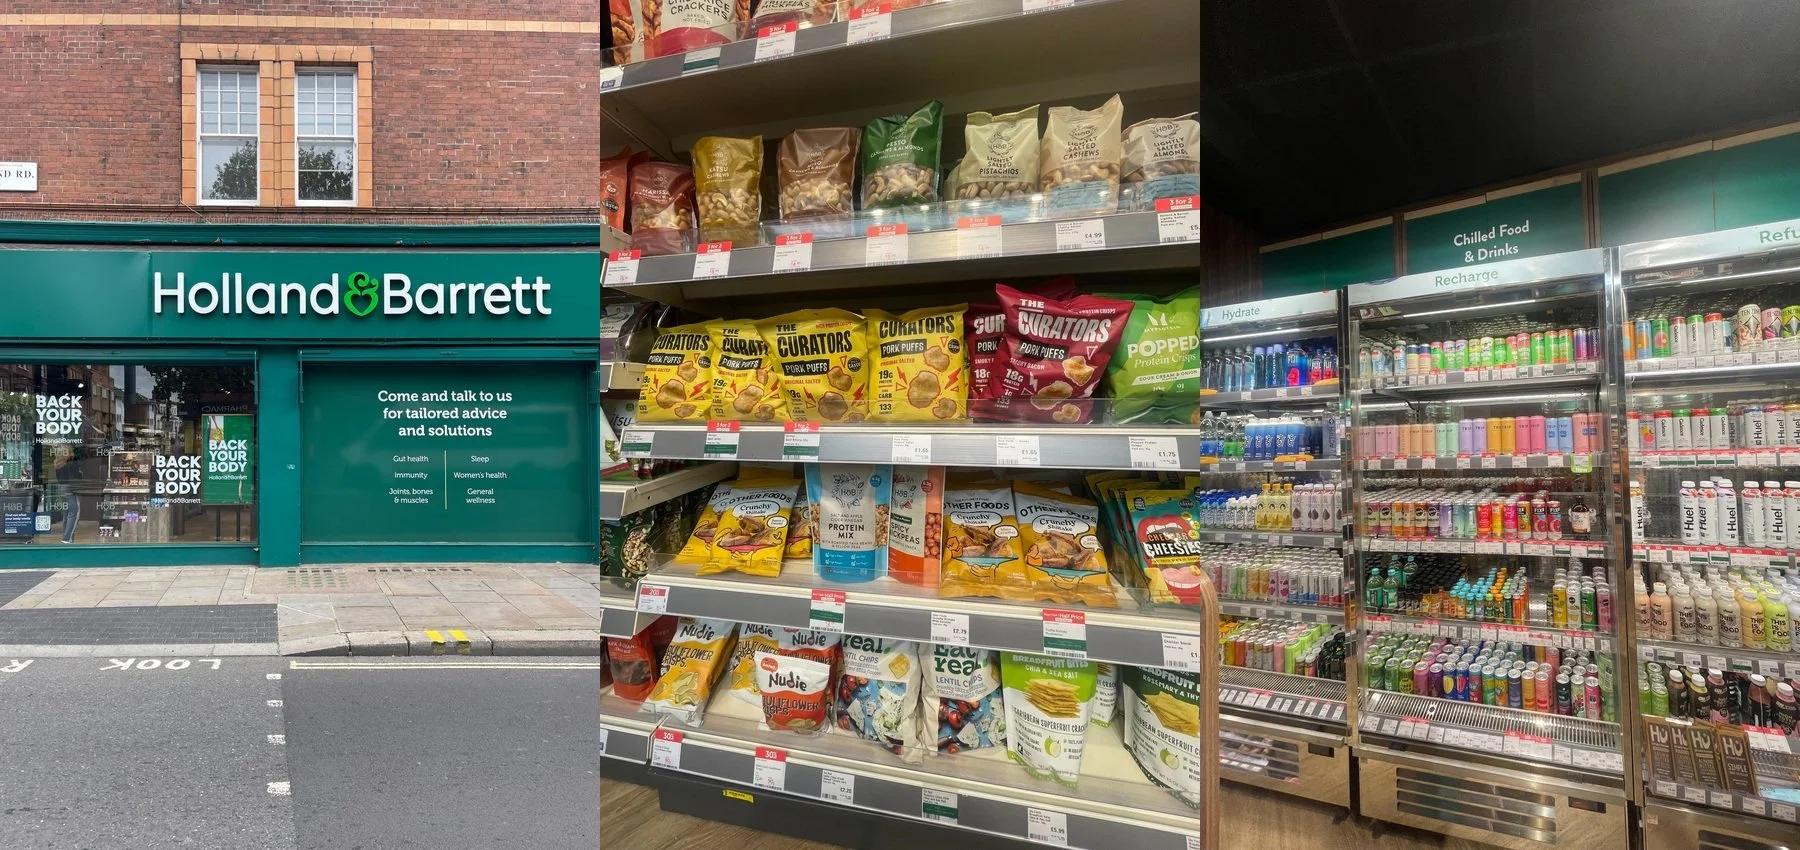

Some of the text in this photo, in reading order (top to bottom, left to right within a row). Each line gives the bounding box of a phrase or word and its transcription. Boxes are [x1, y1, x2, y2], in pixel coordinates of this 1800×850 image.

[670, 2, 729, 20] CRACKERS
[886, 139, 907, 148] PESTO
[1067, 136, 1098, 147] LIGHTLY
[1068, 142, 1096, 153] SALTED
[1153, 137, 1185, 147] LIGHTLY
[1157, 143, 1185, 151] SALTED
[897, 144, 924, 152] ALMONDS
[1063, 149, 1100, 160] CASHEWS
[16, 170, 35, 178] RD.
[642, 188, 670, 196] HARISSA
[1453, 220, 1530, 247] Chilled Food
[1464, 243, 1519, 263] & Drinks
[1434, 268, 1499, 288] Recharge
[154, 271, 552, 317] Holland&Barrett
[1019, 299, 1045, 309] THE
[1222, 305, 1261, 320] Hydrate
[776, 324, 797, 332] THE
[879, 315, 955, 339] CURATORS
[1018, 311, 1112, 343] CURATORS
[653, 334, 710, 350] CURATORS
[777, 330, 853, 358] CURATORS
[882, 342, 924, 354] PORK PUFFS
[977, 340, 997, 351] PORK
[1128, 335, 1200, 359] POPPED
[1019, 343, 1065, 359] PORK PUFFS
[649, 355, 682, 364] PORK PUFFS
[722, 357, 740, 368] PORK
[741, 359, 759, 368] PUFFS
[1134, 353, 1196, 369] Protein Crisps
[785, 362, 828, 374] PORK PUFFS
[878, 370, 893, 379] 19G
[1005, 368, 1024, 382] 18G
[713, 378, 727, 387] 19G
[1004, 378, 1020, 386] PROTEIN
[36, 395, 83, 408] BACK
[378, 390, 513, 402] Come and talk to us
[36, 409, 83, 421] YOUR
[383, 407, 508, 419] for tailored advice
[611, 411, 632, 427] itsu
[36, 422, 83, 434] BODY
[398, 425, 492, 437] and solutions
[1753, 420, 1762, 440] Huel
[1777, 418, 1785, 439] Huel
[209, 439, 248, 450] BACK
[156, 456, 201, 468] BACK
[209, 451, 248, 461] YOUR
[393, 455, 429, 463] Gut health
[471, 455, 490, 464] Sleep
[209, 462, 248, 472] BODY
[156, 469, 201, 481] YOUR
[394, 472, 428, 480] Immunity
[155, 482, 201, 494] BODY
[389, 488, 411, 496] Joints,
[394, 496, 429, 504] & muscles
[466, 496, 496, 504] wellness
[728, 491, 793, 505] OTHER FOODS
[740, 502, 772, 511] Crunchy
[974, 501, 1010, 510] FOODS
[956, 513, 991, 521] Crunchy
[1020, 506, 1097, 523] OTHER FOODS
[1684, 505, 1694, 531] Huel
[1699, 506, 1707, 531] Huel
[1727, 505, 1737, 531] Huel
[1771, 506, 1783, 533] Huel
[828, 523, 865, 532] PROTEIN
[890, 522, 910, 534] SPICY
[1039, 518, 1076, 527] Crunchy
[1771, 618, 1786, 626] THIS
[680, 623, 715, 641] Nudie
[744, 623, 774, 637] Nudie
[1720, 625, 1740, 633] FOOD
[792, 631, 827, 646] Nudie
[100, 658, 223, 671] LOOK
[858, 655, 879, 663] CHIPS
[1012, 654, 1089, 668] BREADFRUIT BITES
[1025, 665, 1041, 673] CHIA
[1049, 669, 1062, 678] SEA
[1064, 671, 1079, 679] SALT
[768, 671, 807, 691] Nudie
[936, 674, 983, 687] LENTIL CHIPS
[1142, 674, 1180, 695] ROSEMARY
[1040, 719, 1071, 733] SUPERFRUIT
[1156, 730, 1194, 750] SUPERFRUIT
[1727, 763, 1748, 772] SIMPLE
[1050, 826, 1065, 834] £5.99
